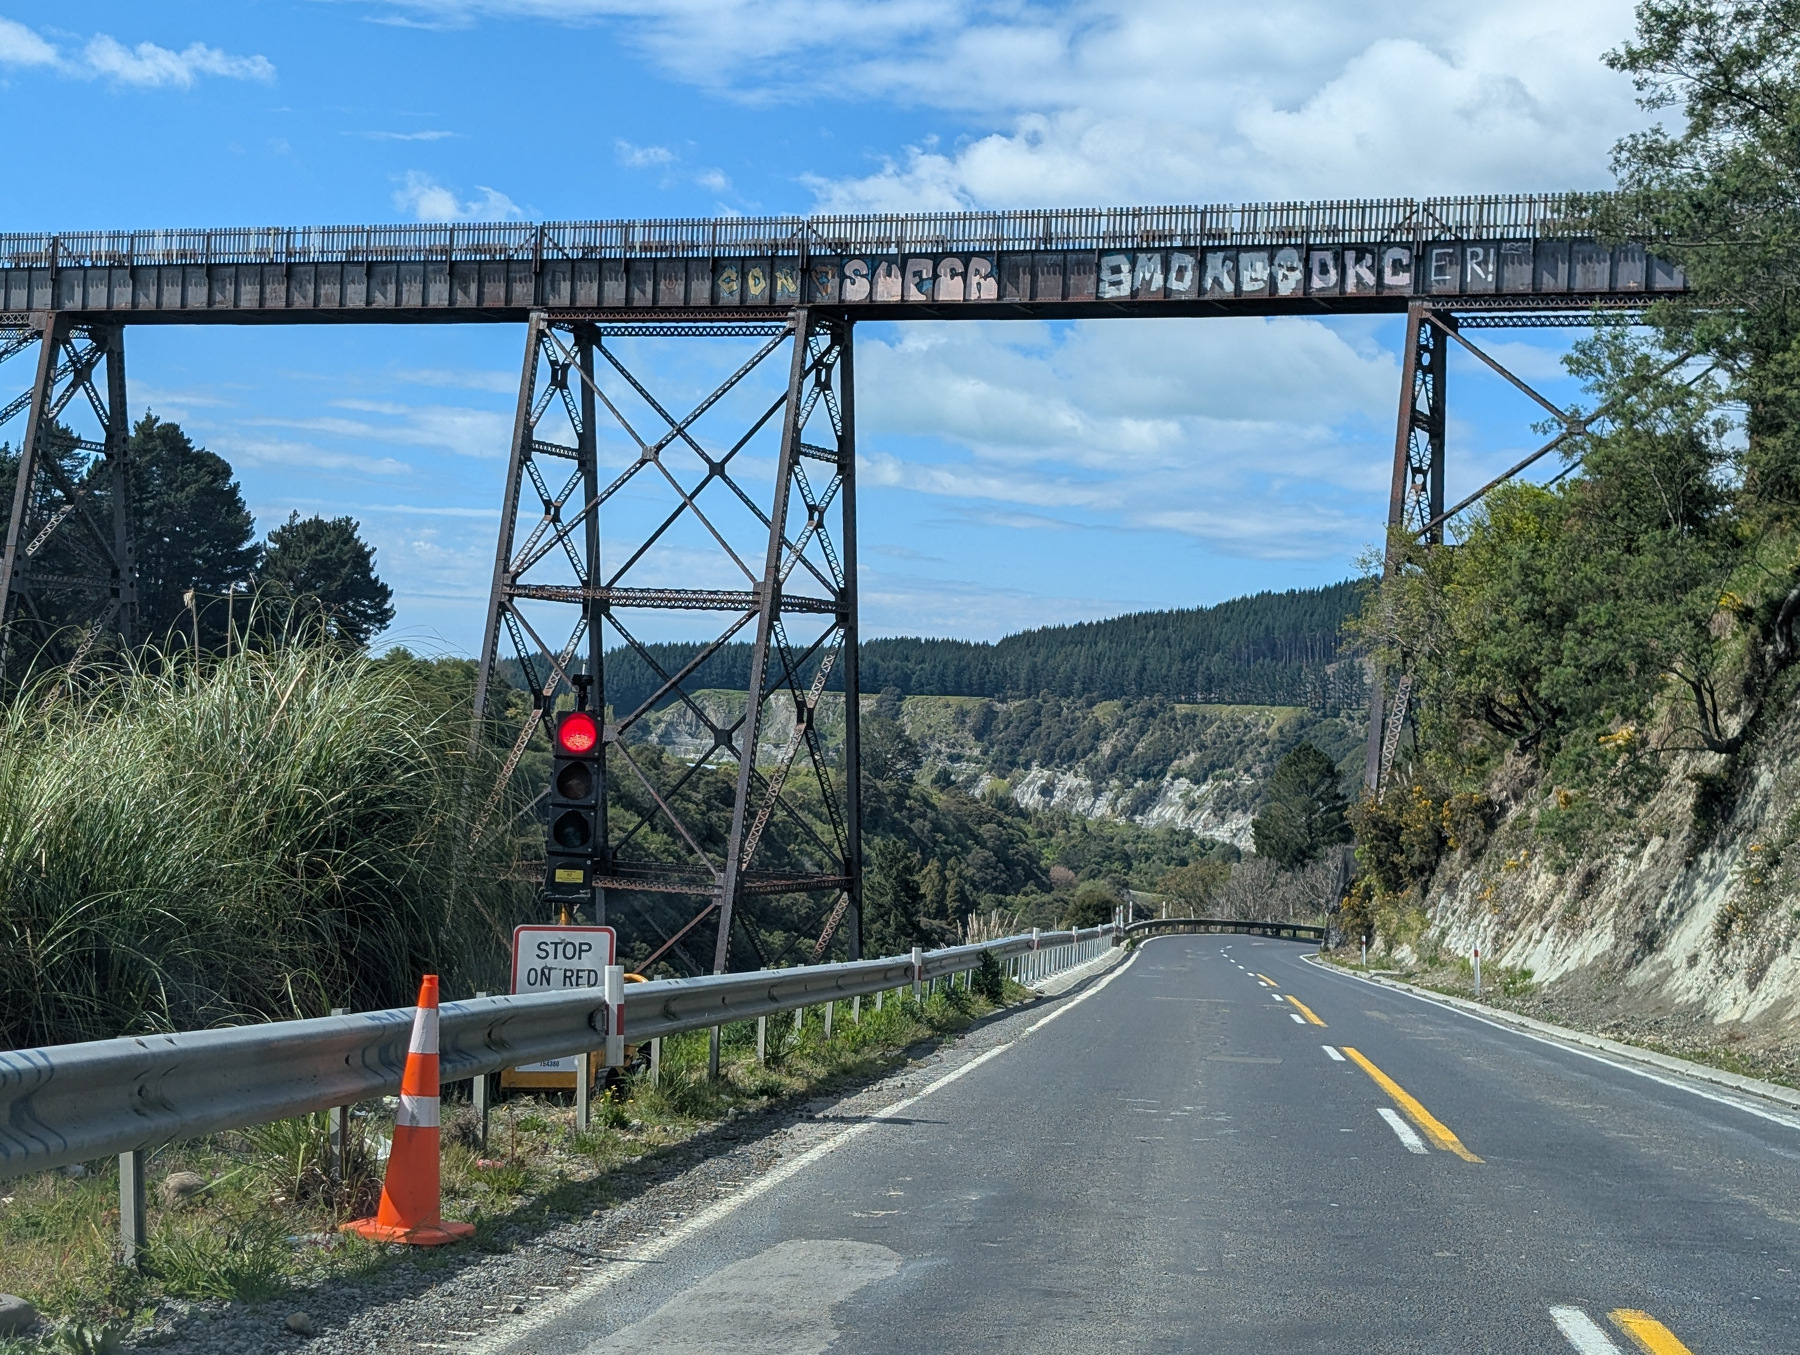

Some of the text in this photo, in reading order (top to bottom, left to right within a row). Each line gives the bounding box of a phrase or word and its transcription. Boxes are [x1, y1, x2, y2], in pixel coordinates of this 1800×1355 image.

[535, 941, 593, 960] STOP
[526, 967, 599, 988] ON RED
